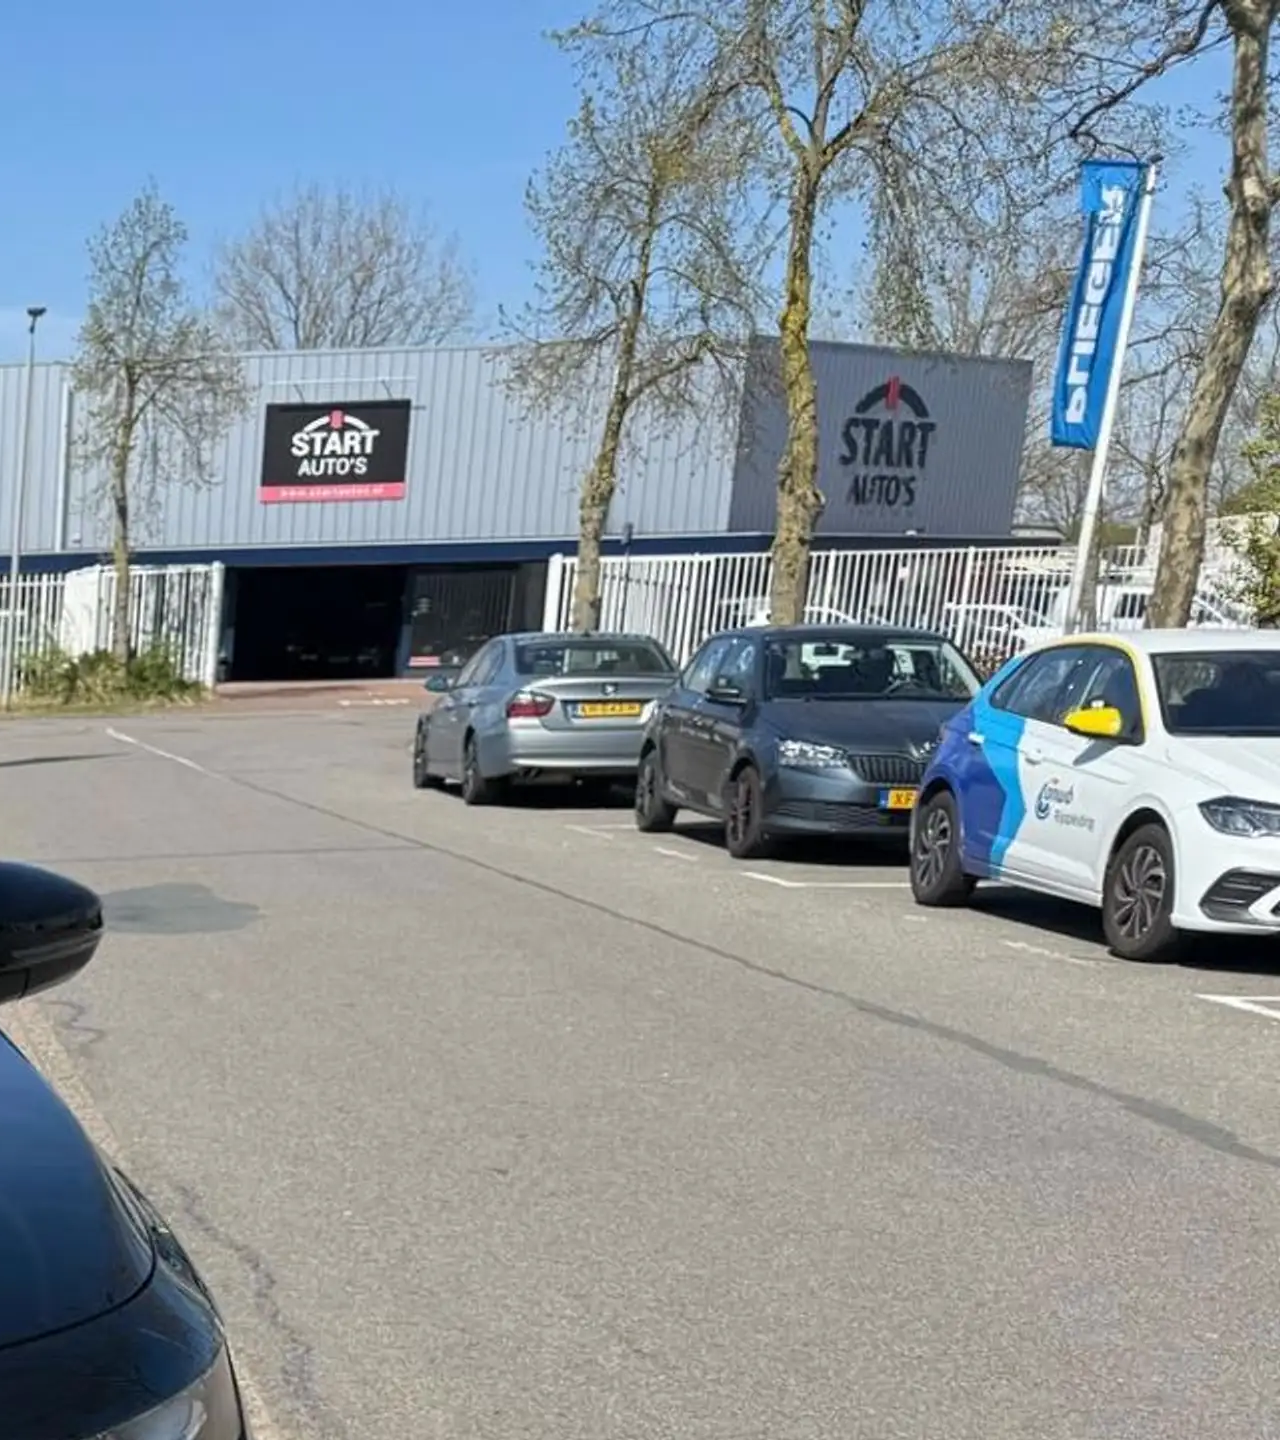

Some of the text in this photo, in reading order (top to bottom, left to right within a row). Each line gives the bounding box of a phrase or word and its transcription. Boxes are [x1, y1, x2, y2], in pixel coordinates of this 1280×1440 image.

[291, 429, 380, 456] START
[839, 416, 937, 469] START
[297, 456, 368, 477] AUTO'S
[846, 473, 916, 507] AUTO'S
